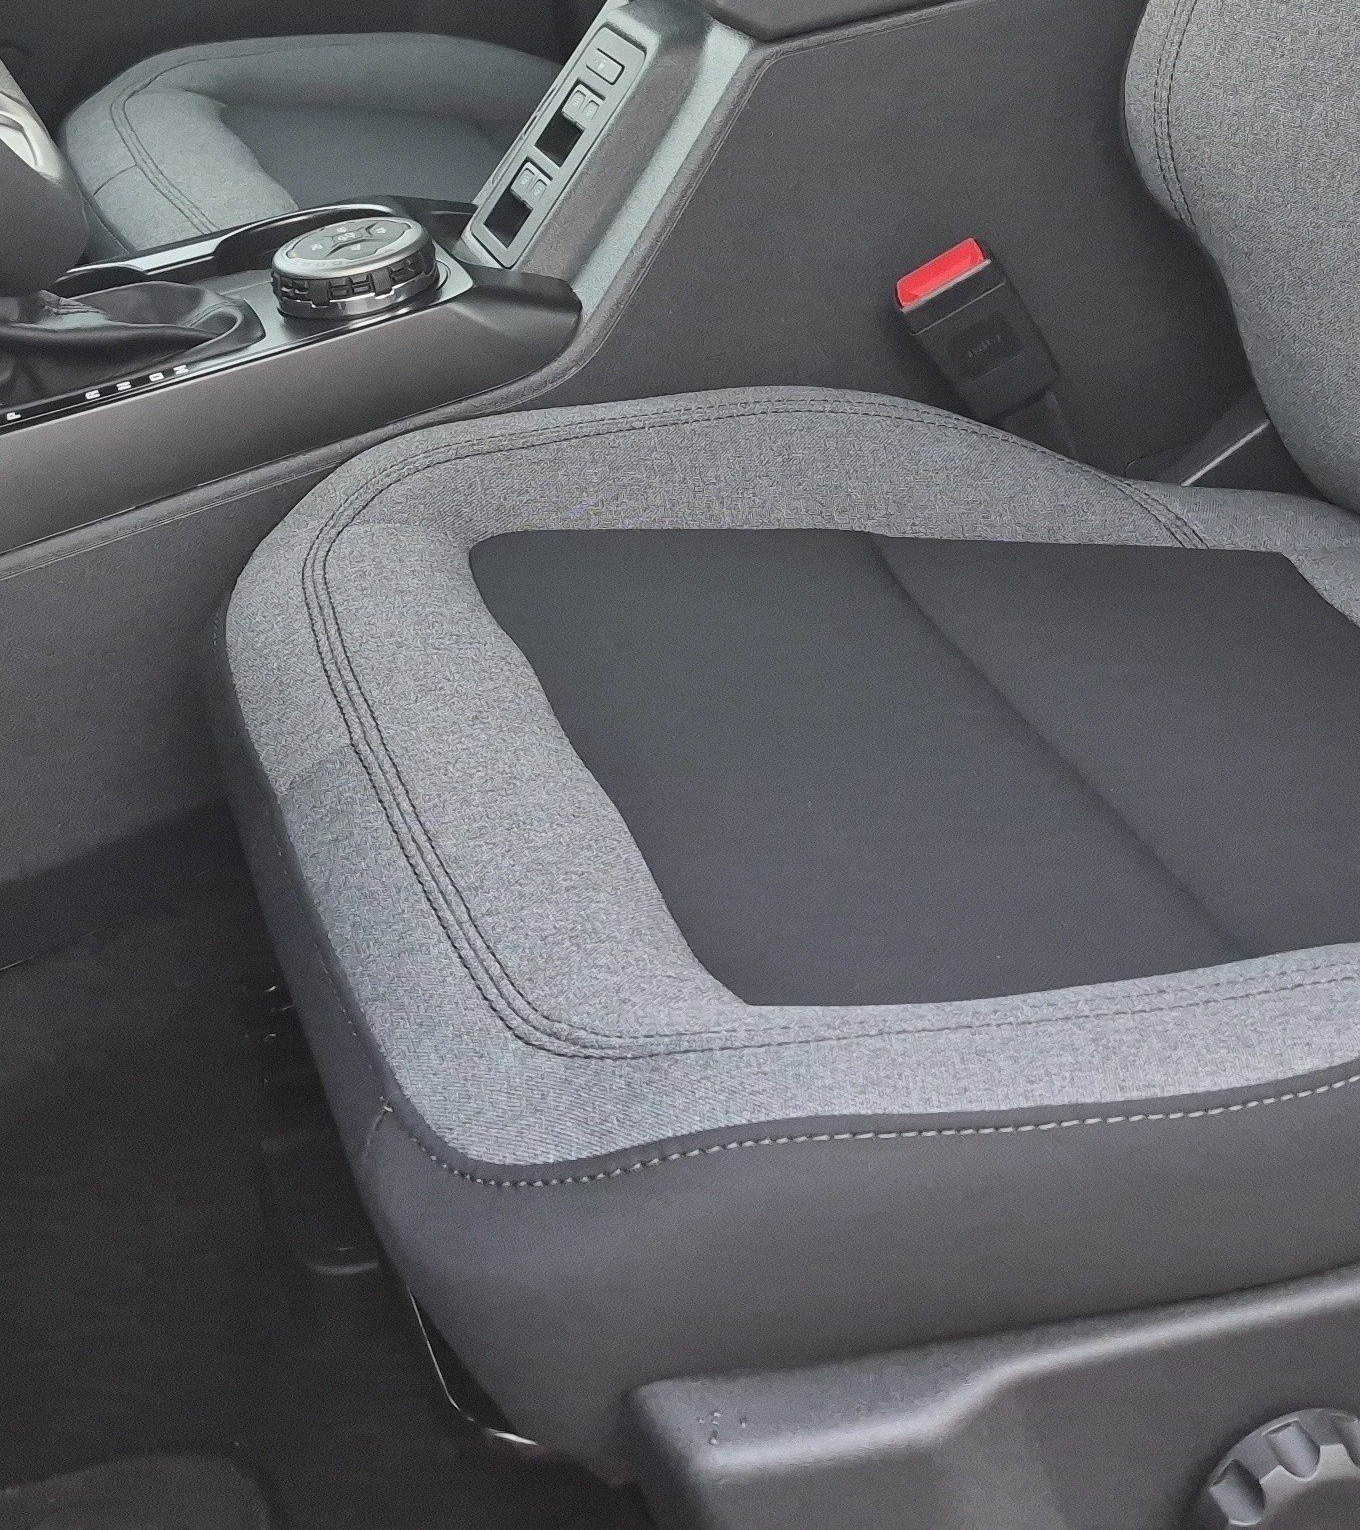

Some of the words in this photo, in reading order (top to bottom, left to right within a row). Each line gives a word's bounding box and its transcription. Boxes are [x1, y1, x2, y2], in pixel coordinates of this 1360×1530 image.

[6, 412, 21, 421] P
[85, 390, 100, 400] R
[116, 381, 132, 391] N
[149, 372, 165, 382] D
